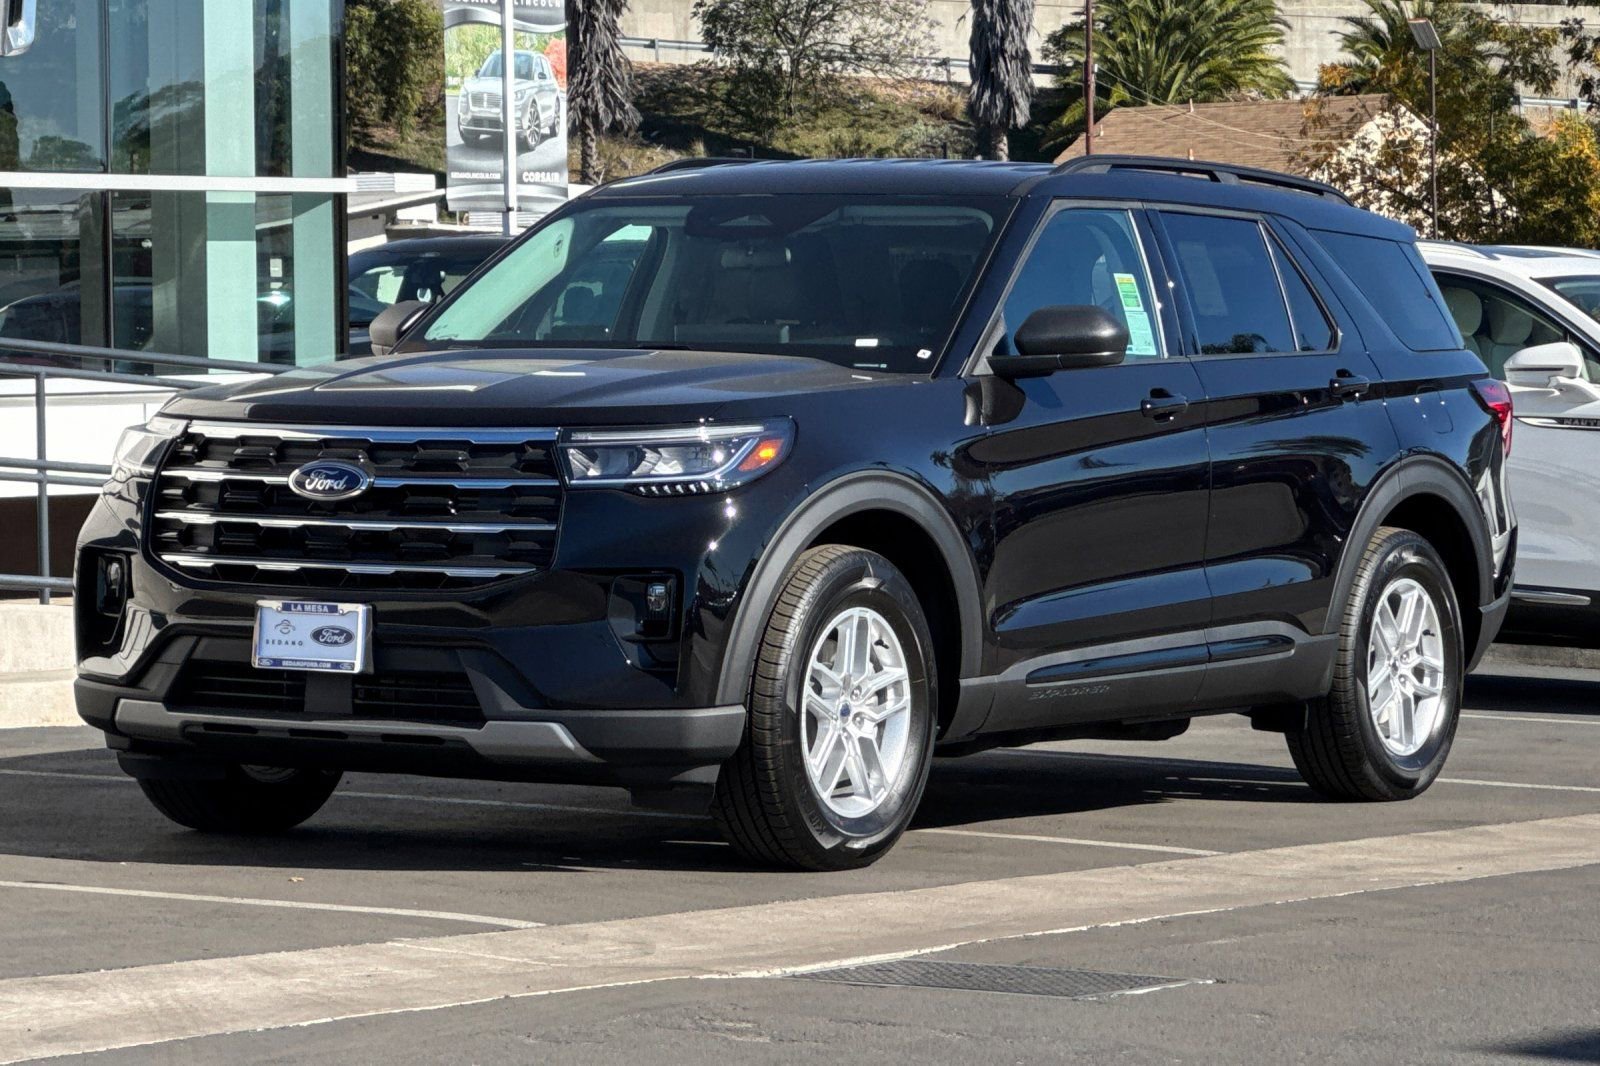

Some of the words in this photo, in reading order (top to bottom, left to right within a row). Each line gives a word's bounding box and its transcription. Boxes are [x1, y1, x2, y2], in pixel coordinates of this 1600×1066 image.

[523, 171, 560, 183] CORSAIR
[305, 469, 348, 491] Ford
[290, 603, 302, 611] LA
[305, 604, 329, 613] MESA
[319, 628, 346, 644] Ford
[265, 638, 304, 647] SEDANO
